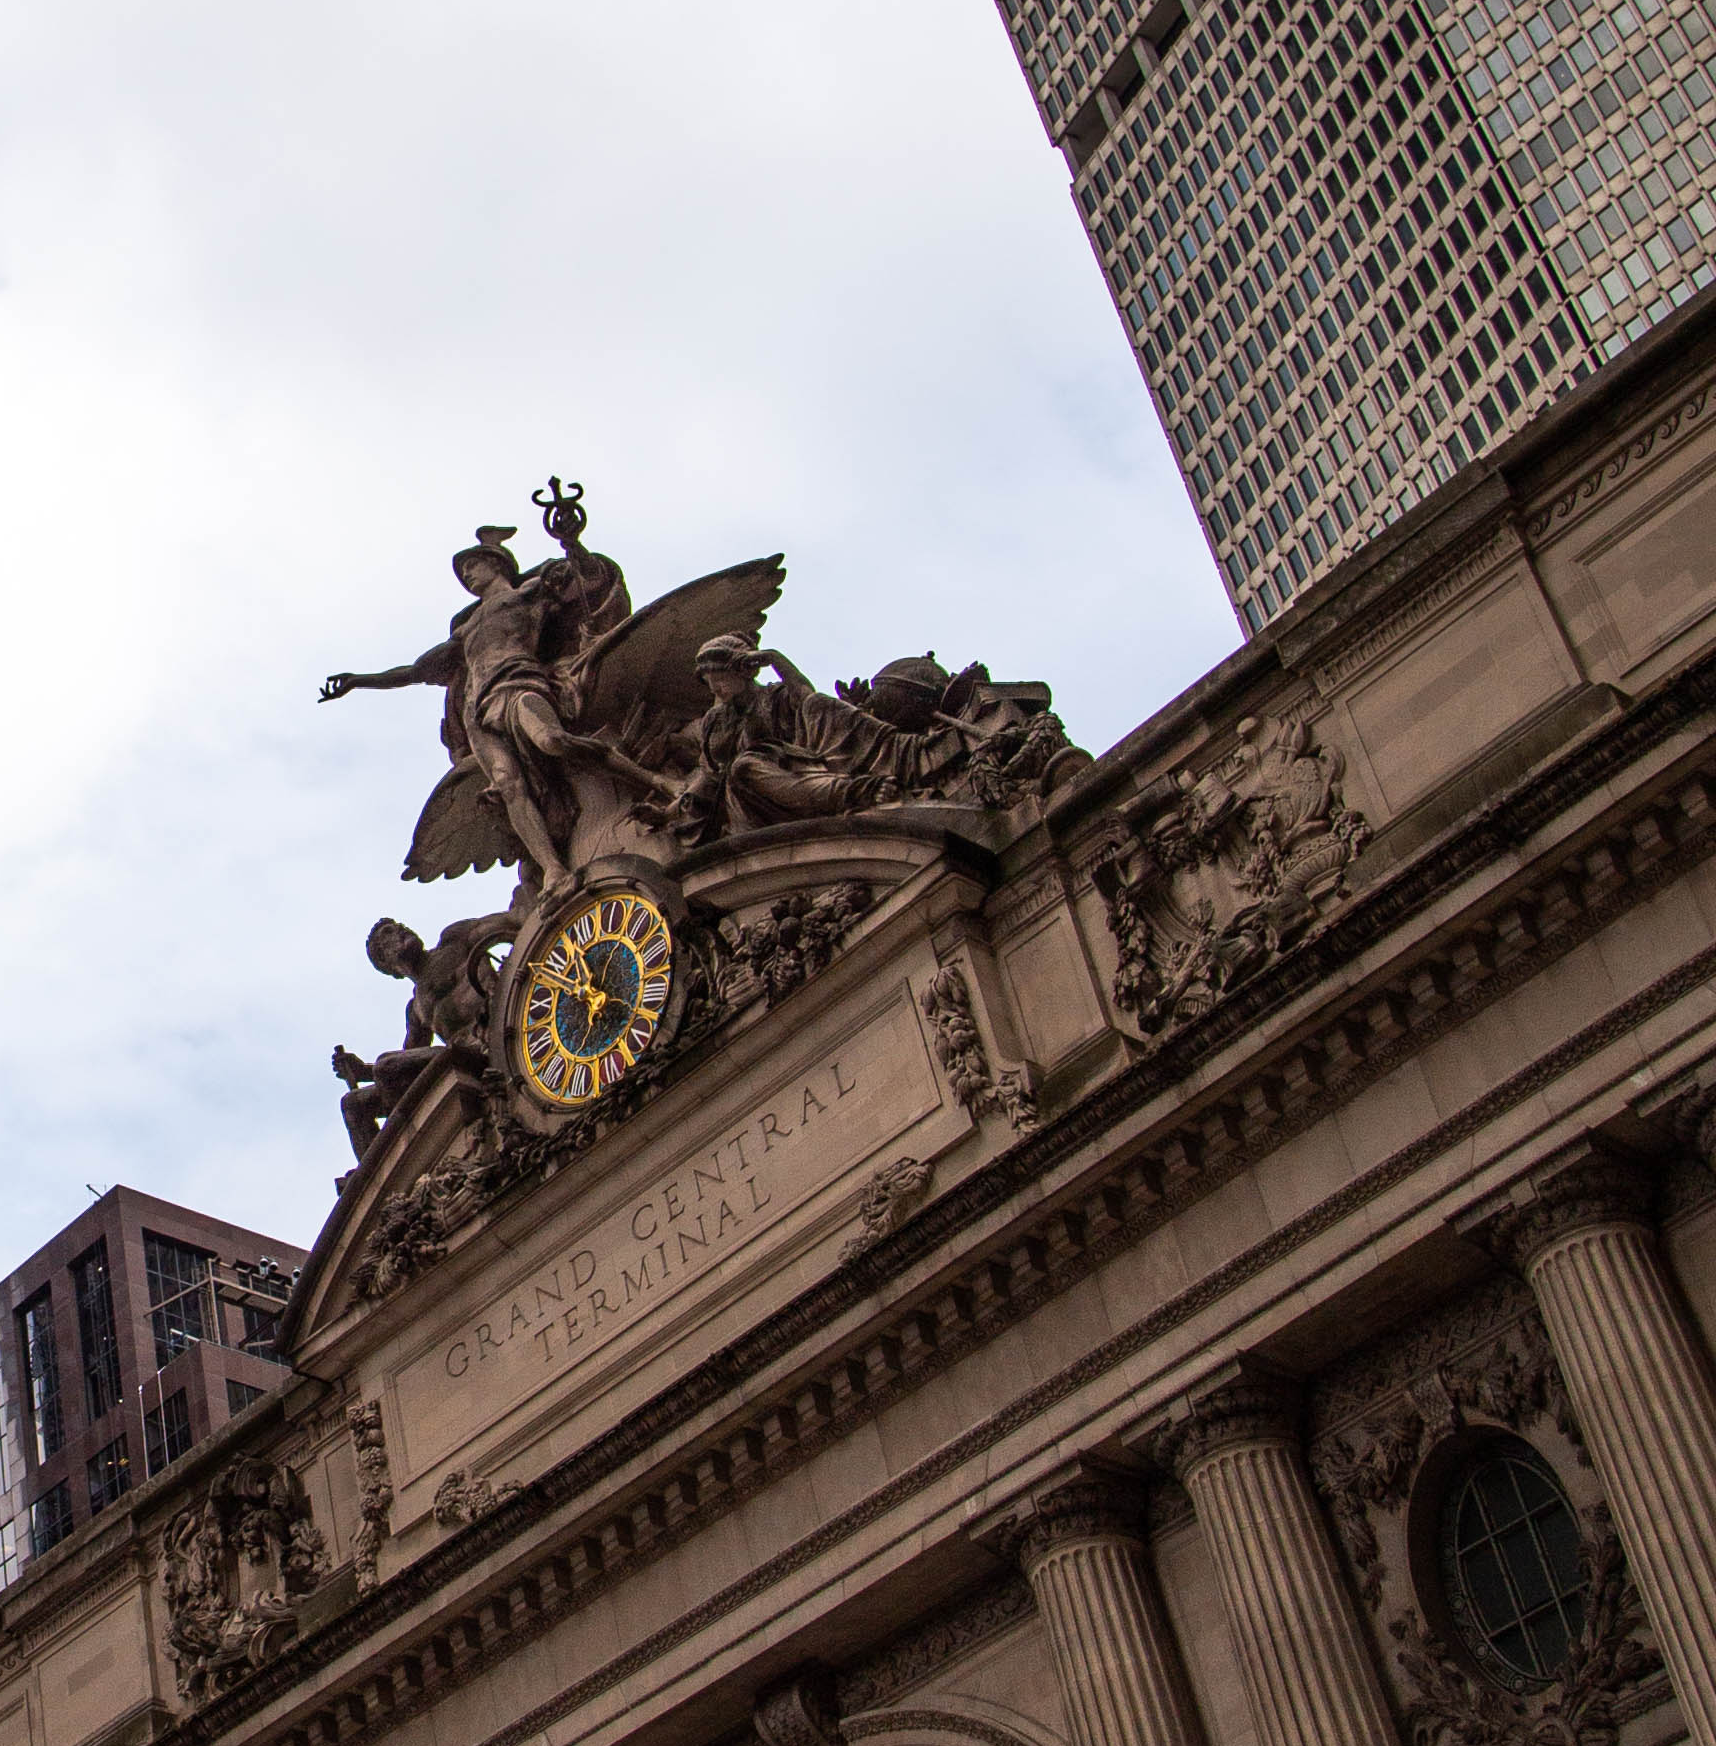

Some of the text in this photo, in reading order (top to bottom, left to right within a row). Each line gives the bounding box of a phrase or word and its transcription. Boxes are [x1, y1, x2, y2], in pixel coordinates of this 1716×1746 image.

[574, 914, 594, 945] XII
[629, 909, 648, 940] II
[643, 939, 667, 964] III
[630, 1027, 650, 1049] V
[445, 1063, 857, 1379] GRAND CENTRAL
[533, 1176, 772, 1363] TERMINAL
